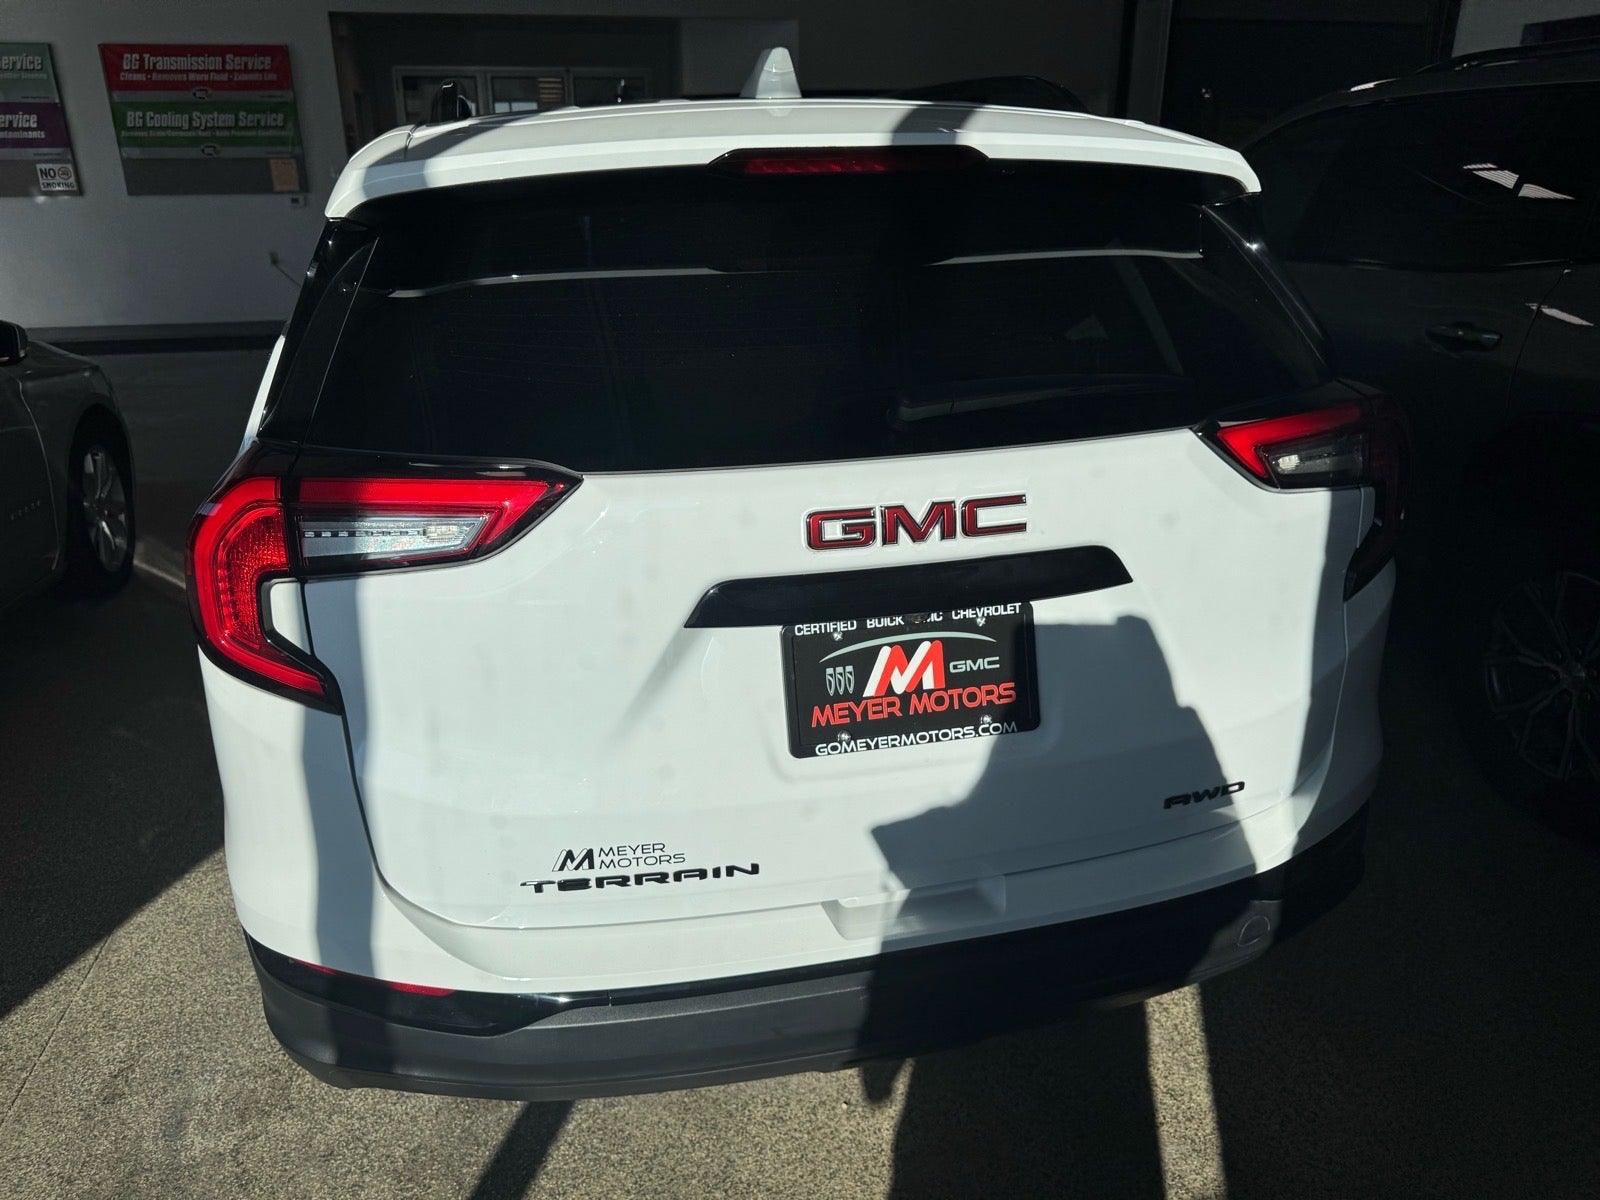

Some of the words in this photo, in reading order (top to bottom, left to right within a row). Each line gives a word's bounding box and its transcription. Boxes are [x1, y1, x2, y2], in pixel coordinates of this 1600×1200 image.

[0, 53, 42, 70] ervice
[123, 54, 140, 70] BG
[144, 54, 223, 70] Transmission
[226, 54, 272, 70] Service
[126, 111, 143, 127] BG
[146, 111, 189, 129] Cooling
[192, 111, 235, 129] System
[238, 111, 284, 127] Service
[39, 168, 57, 179] NO
[806, 494, 1027, 551] GMC
[794, 620, 857, 637] CERTIFIED
[866, 615, 905, 629] BUICK
[951, 602, 1022, 620] CHEVROLET
[949, 656, 1000, 674] GMC
[811, 696, 902, 728] MEYER
[909, 682, 1017, 716] MOTORS
[815, 721, 1018, 756] GOMEYERMOTORS.COM
[1164, 781, 1246, 809] AWD
[598, 842, 666, 857] MEYER
[599, 852, 686, 869] MOTORS
[520, 863, 760, 893] TERRAIN
